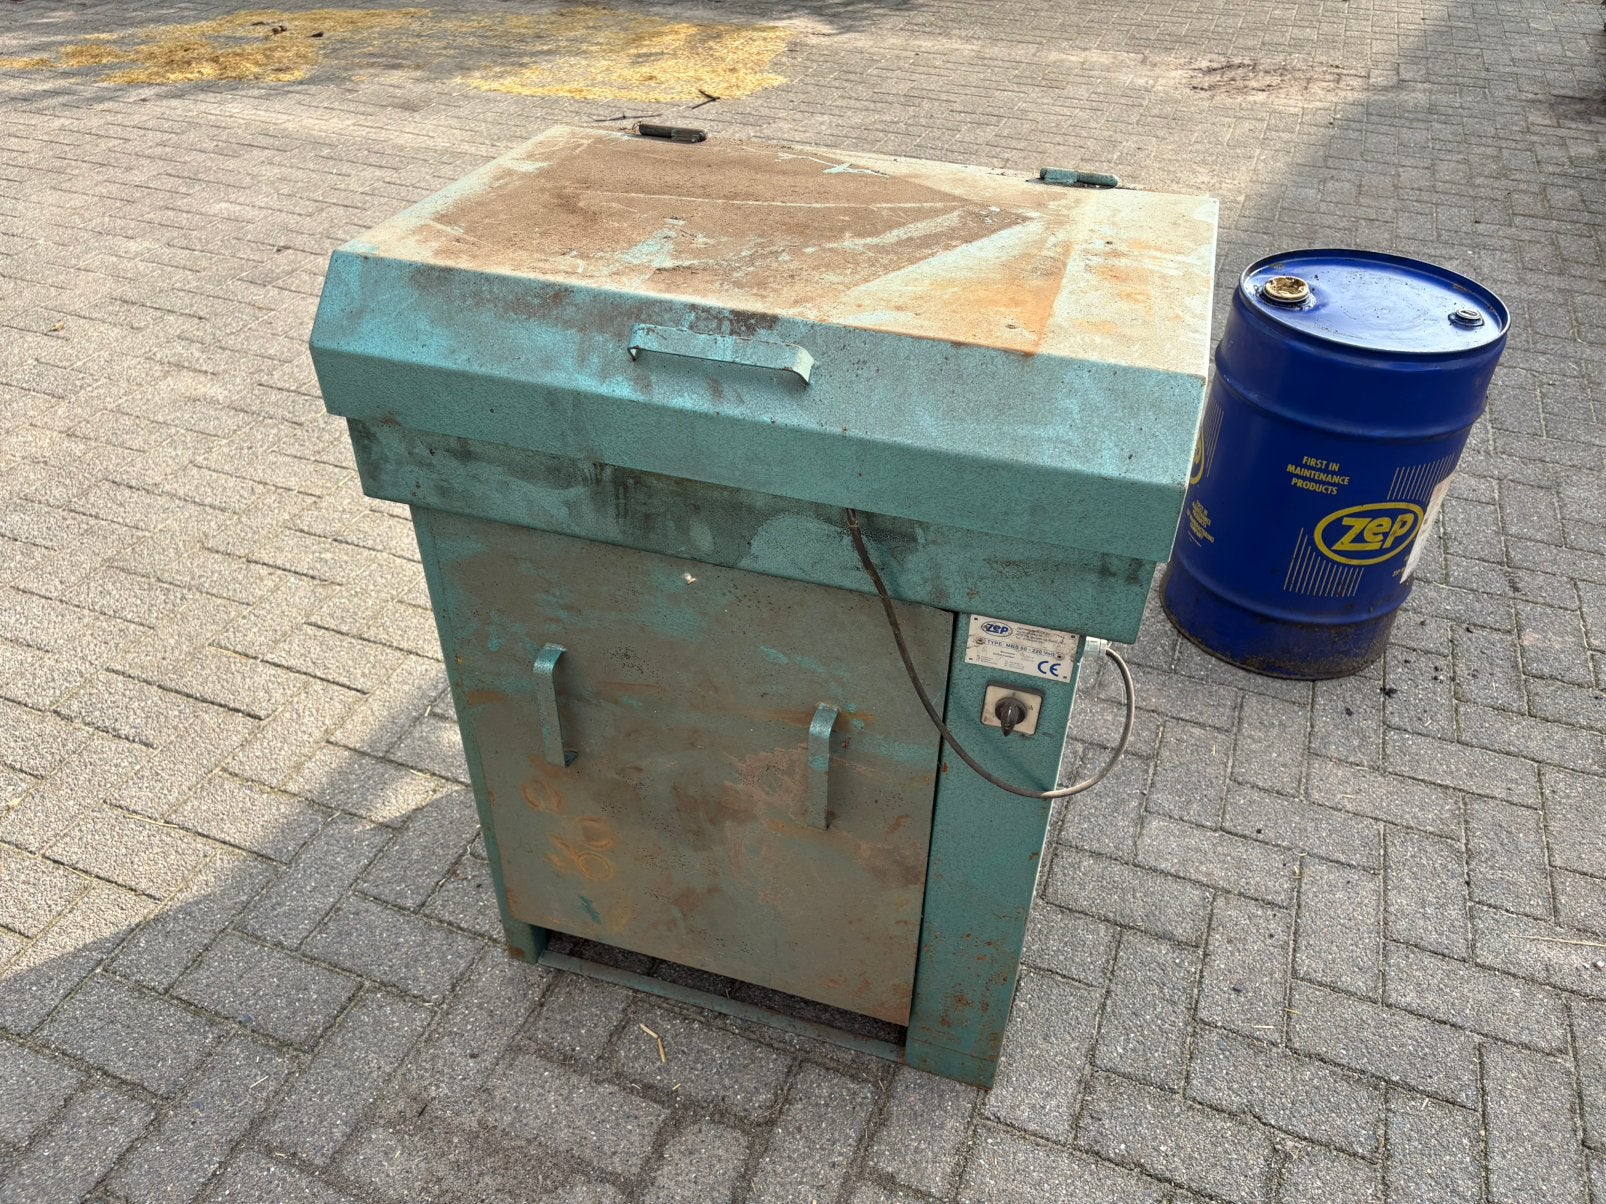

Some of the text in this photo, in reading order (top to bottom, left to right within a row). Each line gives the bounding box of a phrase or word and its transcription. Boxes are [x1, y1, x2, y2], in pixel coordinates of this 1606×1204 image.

[1302, 456, 1340, 472] FIRST IN
[1286, 464, 1350, 485] MAINTENANCE
[1291, 477, 1338, 495] PRODUCTS
[1037, 660, 1062, 677] CE
